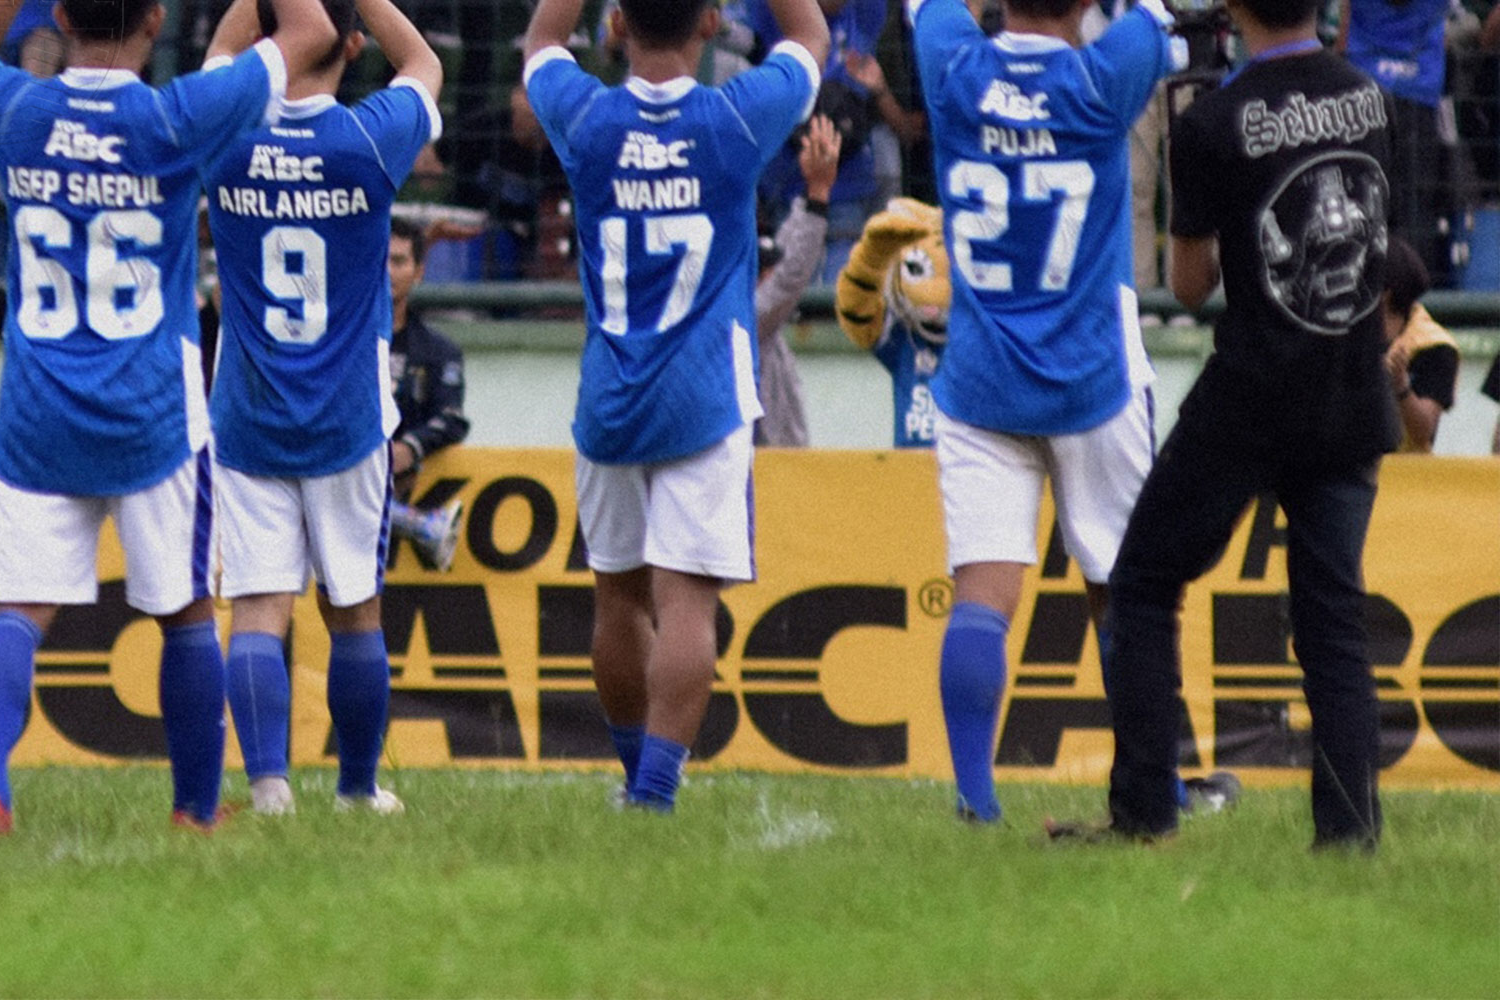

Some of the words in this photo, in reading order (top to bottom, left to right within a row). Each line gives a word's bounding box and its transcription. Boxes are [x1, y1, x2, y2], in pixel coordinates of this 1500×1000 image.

[43, 130, 122, 164] ABC
[618, 140, 689, 170] ABC
[982, 124, 1058, 156] PUJA
[7, 165, 60, 203] ASEP
[66, 171, 165, 208] SAEPUL
[247, 155, 325, 183] ABC
[217, 185, 370, 220] AIRLANGGA
[612, 176, 700, 211] WANDI
[948, 159, 1096, 293] 27
[14, 205, 165, 341] 66
[261, 226, 329, 345] 9
[599, 213, 715, 337] 17
[324, 584, 908, 767] ABC
